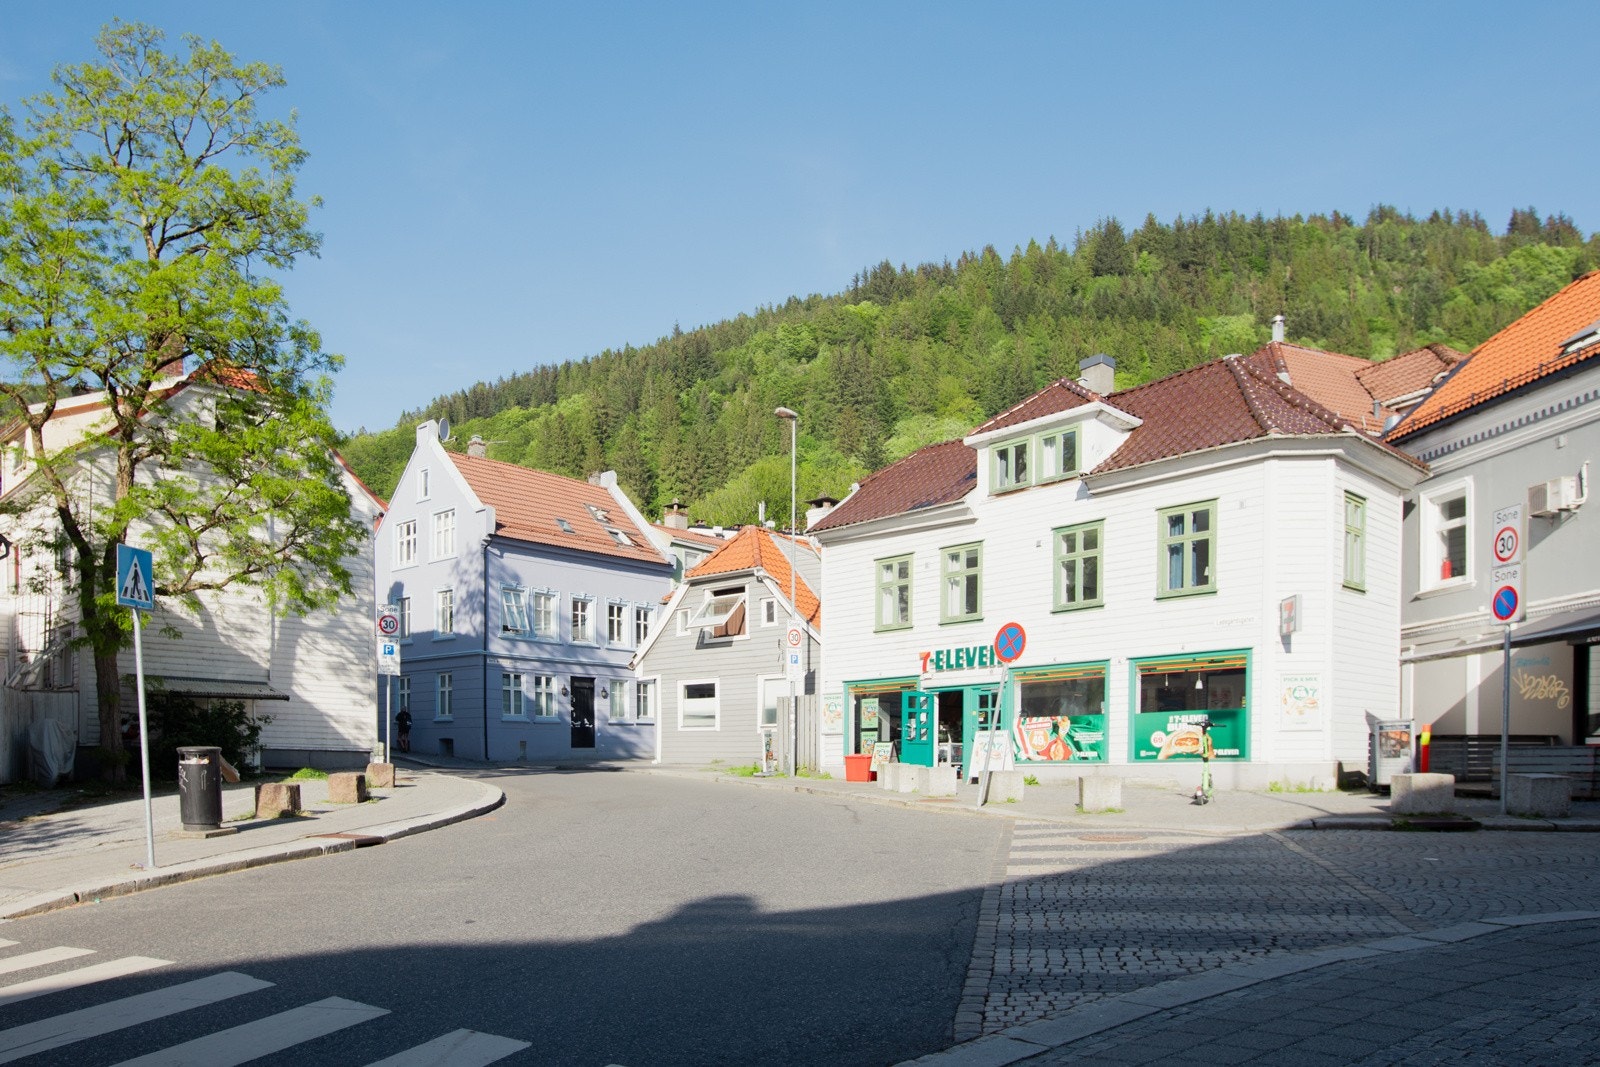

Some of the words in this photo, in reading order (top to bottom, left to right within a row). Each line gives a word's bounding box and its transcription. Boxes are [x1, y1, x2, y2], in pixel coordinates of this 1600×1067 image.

[1496, 511, 1518, 524] Sone
[1499, 535, 1514, 553] 30
[1494, 570, 1518, 582] Sone
[382, 619, 395, 630] 30
[790, 633, 799, 642] 30
